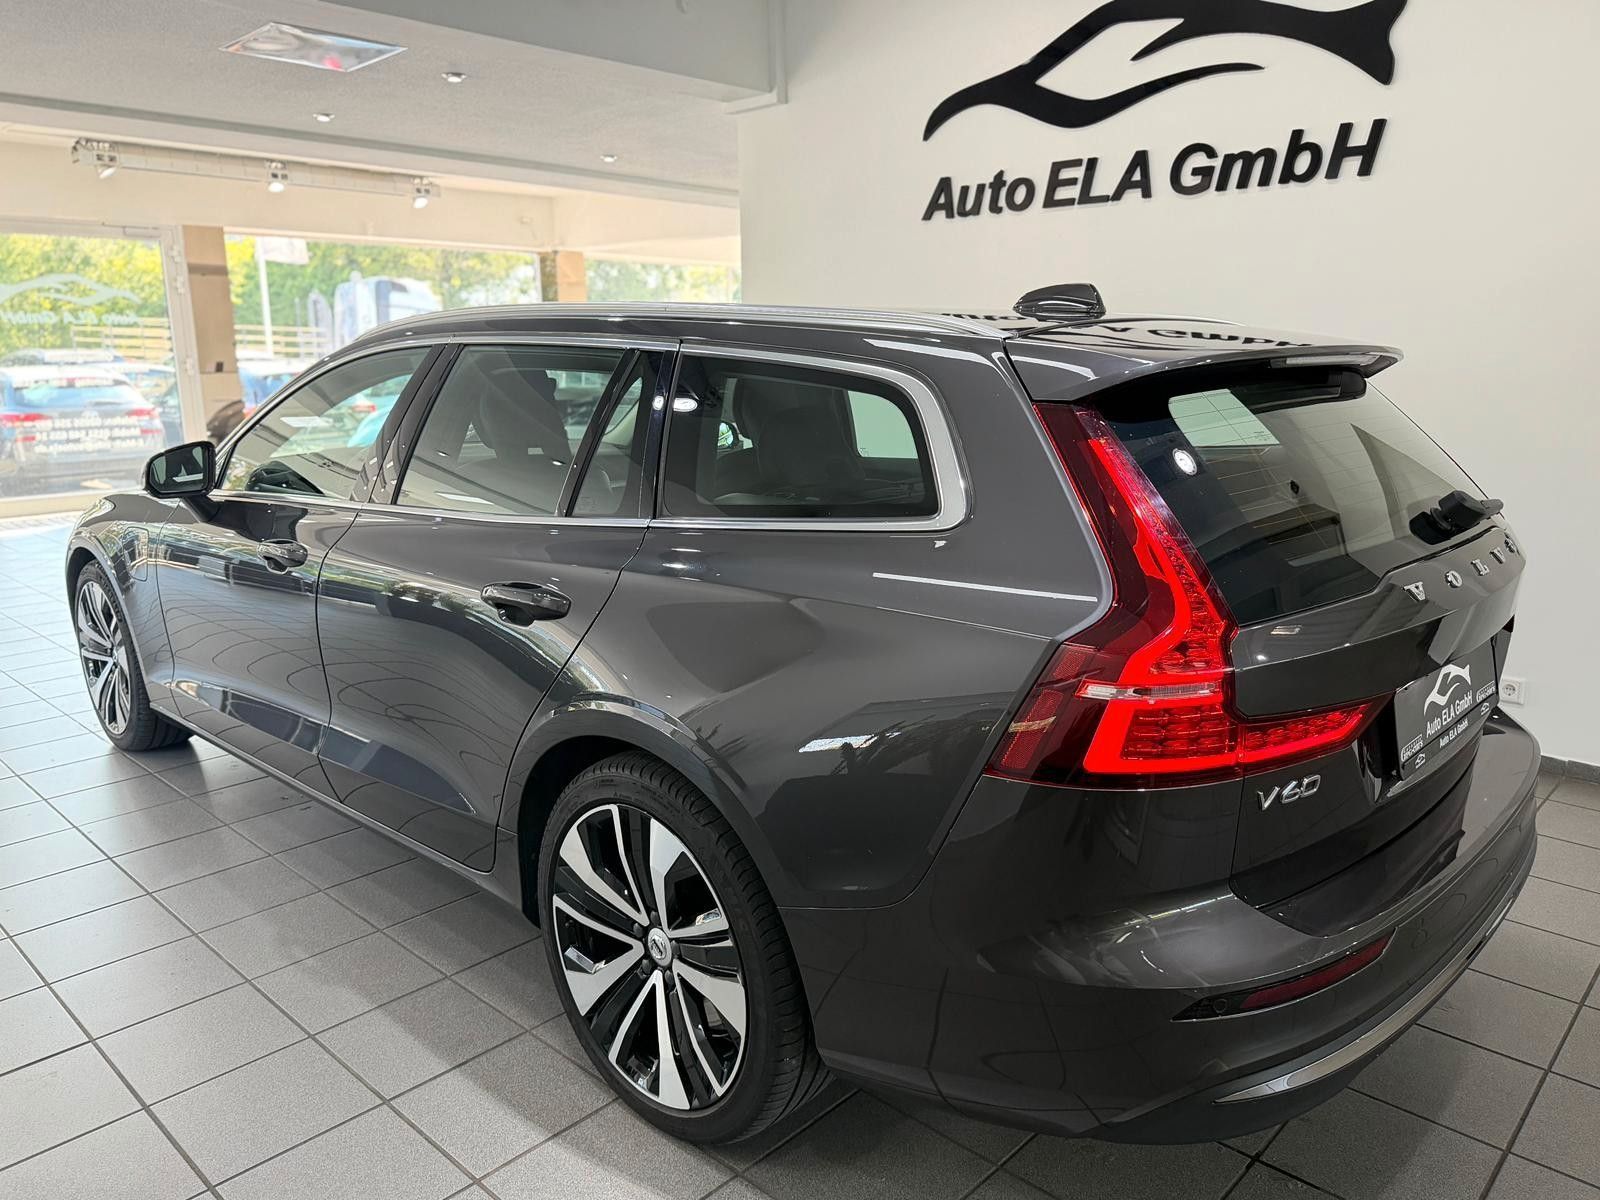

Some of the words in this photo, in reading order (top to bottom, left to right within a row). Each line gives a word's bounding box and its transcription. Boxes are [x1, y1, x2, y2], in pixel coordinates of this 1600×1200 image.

[922, 170, 1035, 221] Auto
[1042, 150, 1152, 208] ELA
[1169, 118, 1387, 195] GmbH
[1426, 717, 1442, 738] Auto
[1441, 704, 1456, 726] ELA
[1455, 690, 1473, 715] GmbH
[1257, 774, 1321, 811] V60
